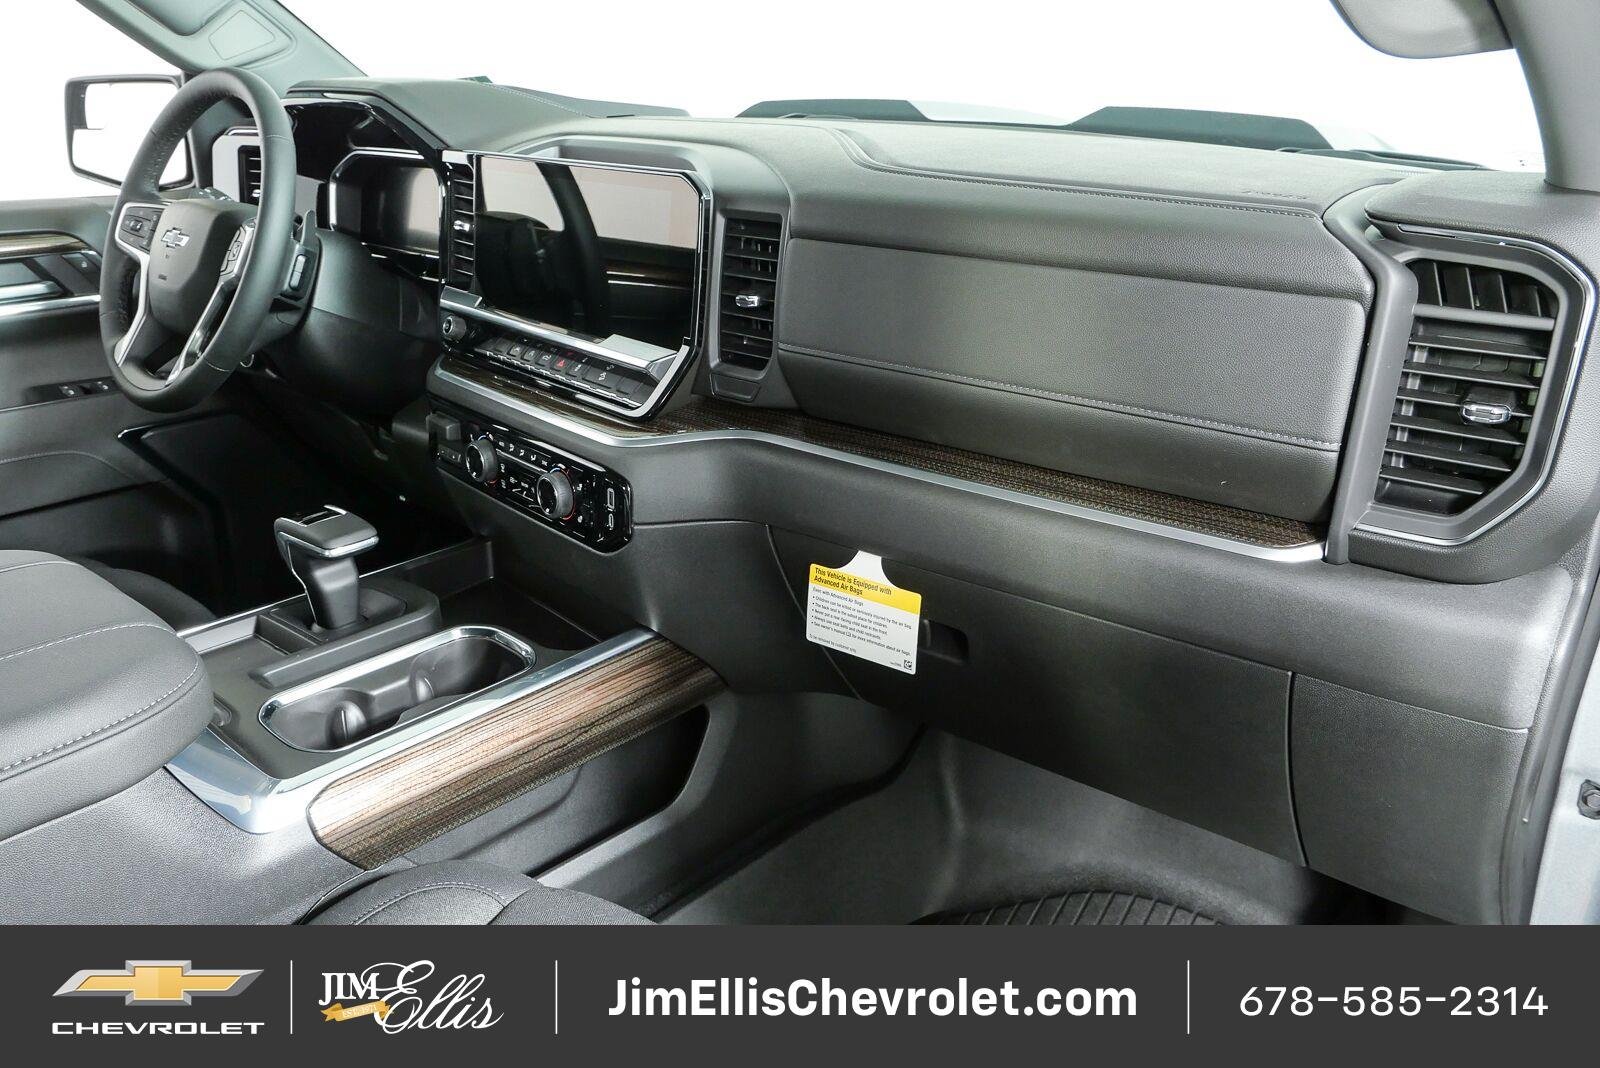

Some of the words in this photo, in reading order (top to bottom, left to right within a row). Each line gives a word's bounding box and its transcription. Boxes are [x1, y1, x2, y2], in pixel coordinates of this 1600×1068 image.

[814, 575, 839, 588] Advanced
[850, 585, 863, 596] Bags
[815, 567, 826, 576] This
[827, 571, 846, 582] Vehicle
[853, 578, 878, 592] Equipped
[879, 586, 892, 595] with
